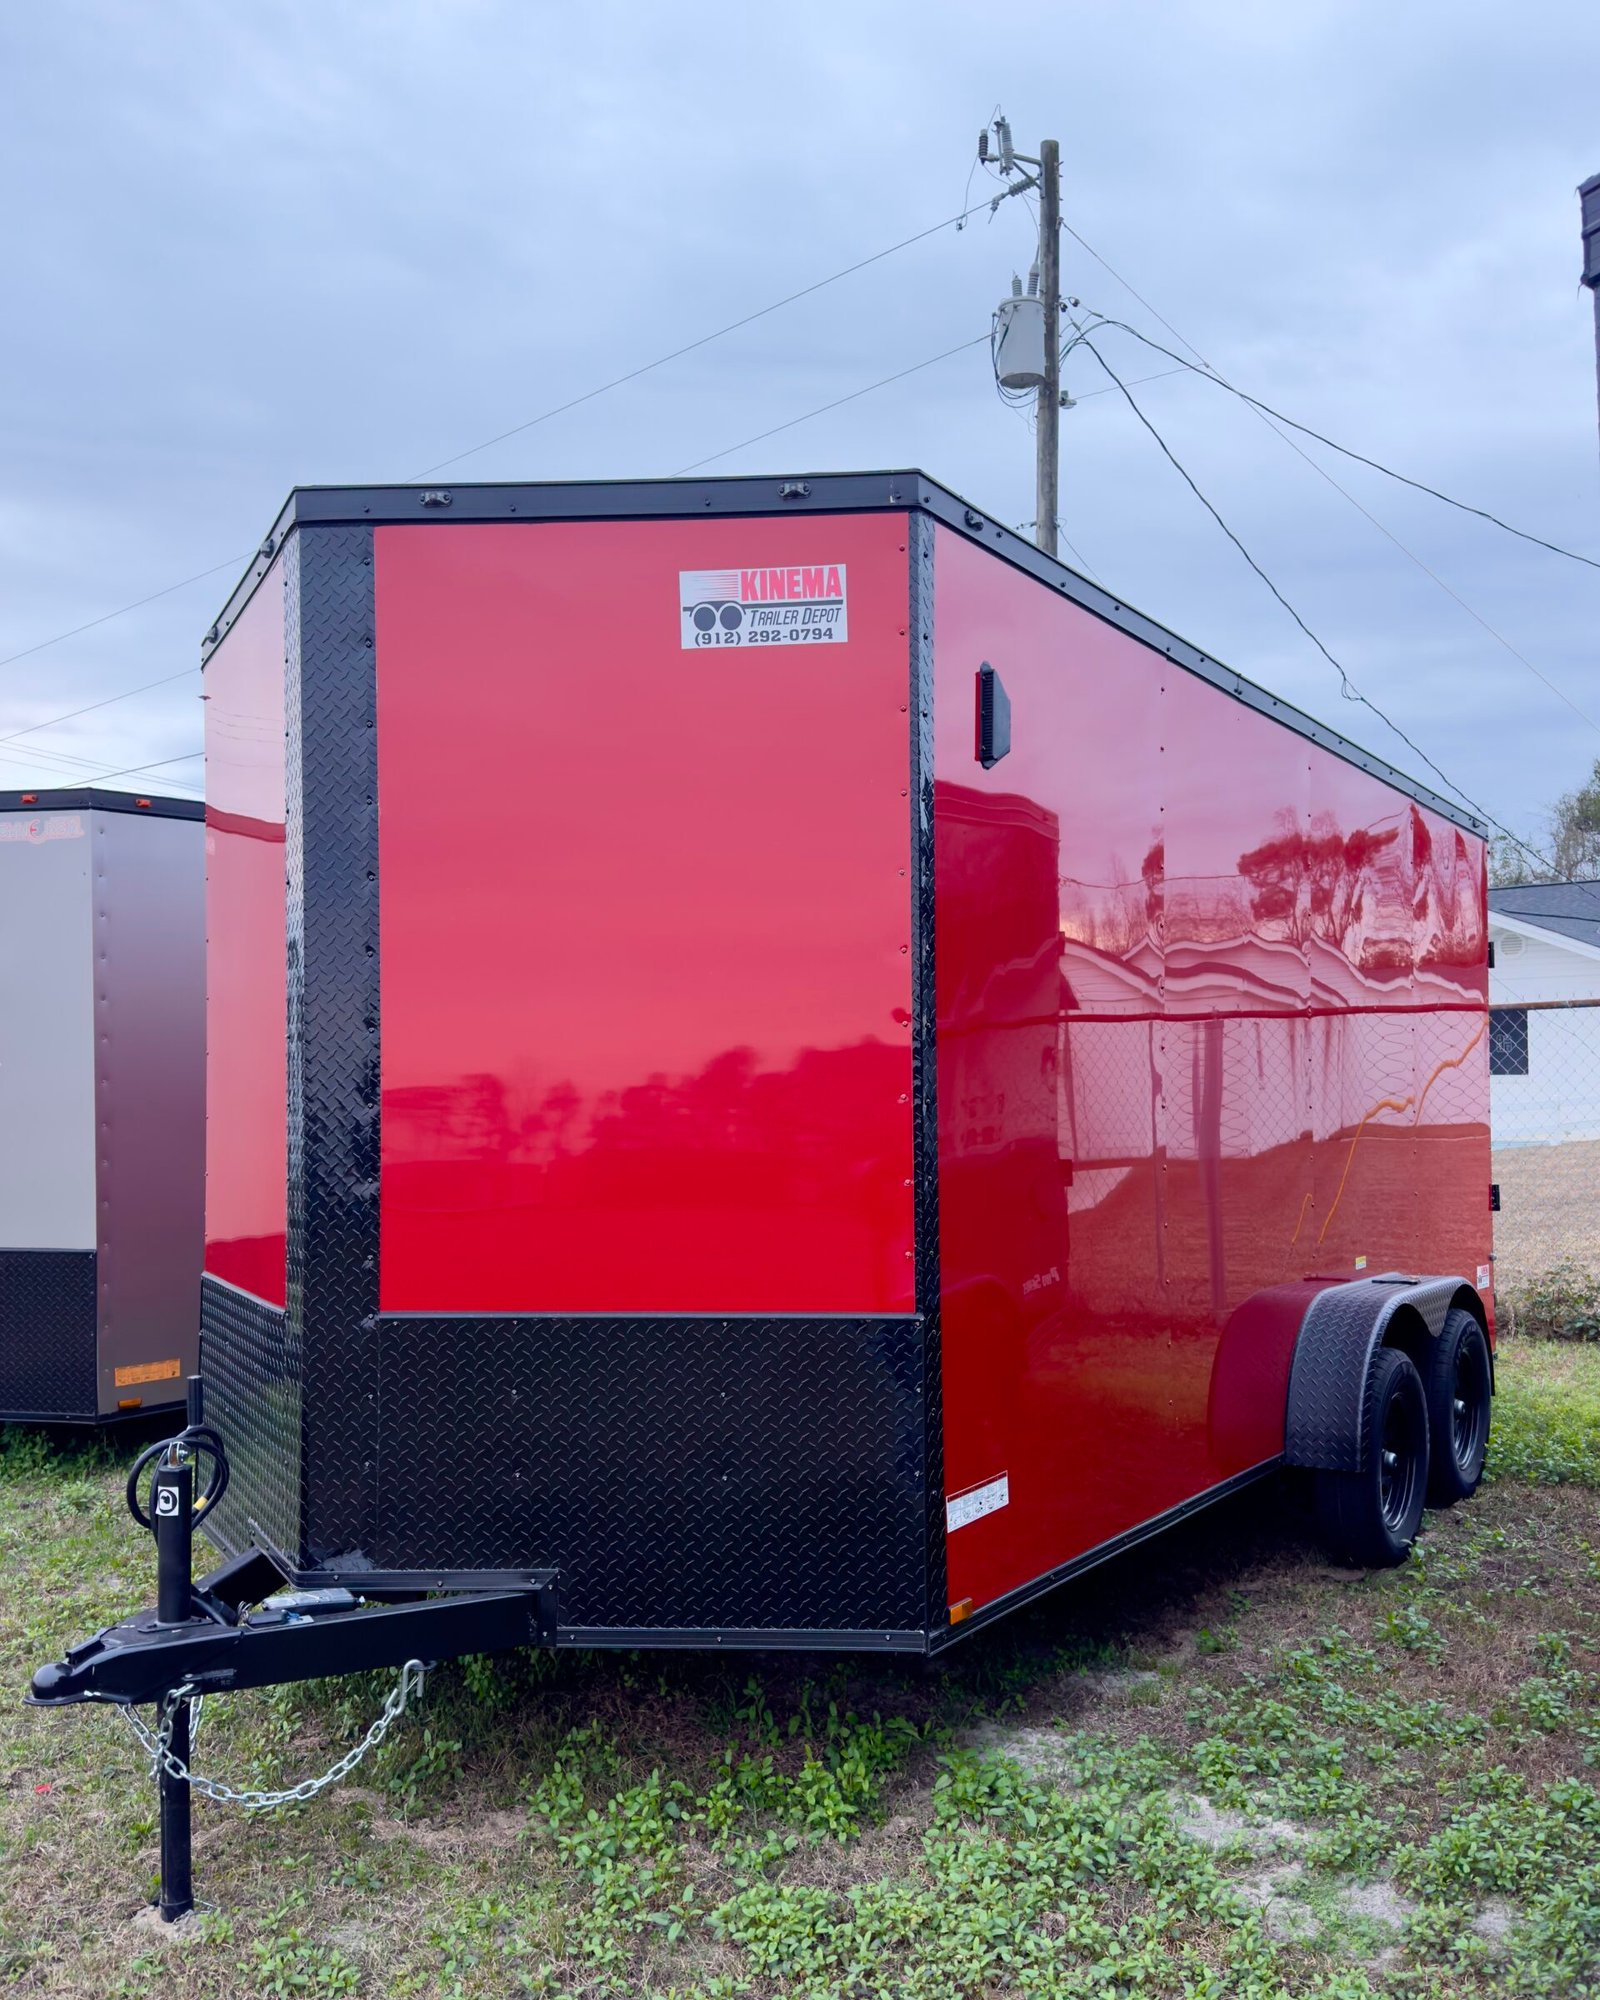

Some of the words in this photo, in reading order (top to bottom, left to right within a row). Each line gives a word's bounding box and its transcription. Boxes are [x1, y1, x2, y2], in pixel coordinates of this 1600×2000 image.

[740, 566, 843, 602] KINEMA
[750, 609, 799, 627] TRAILER
[801, 607, 842, 625] DEPOT
[694, 631, 742, 647] (912)
[748, 627, 834, 643] 292-0794
